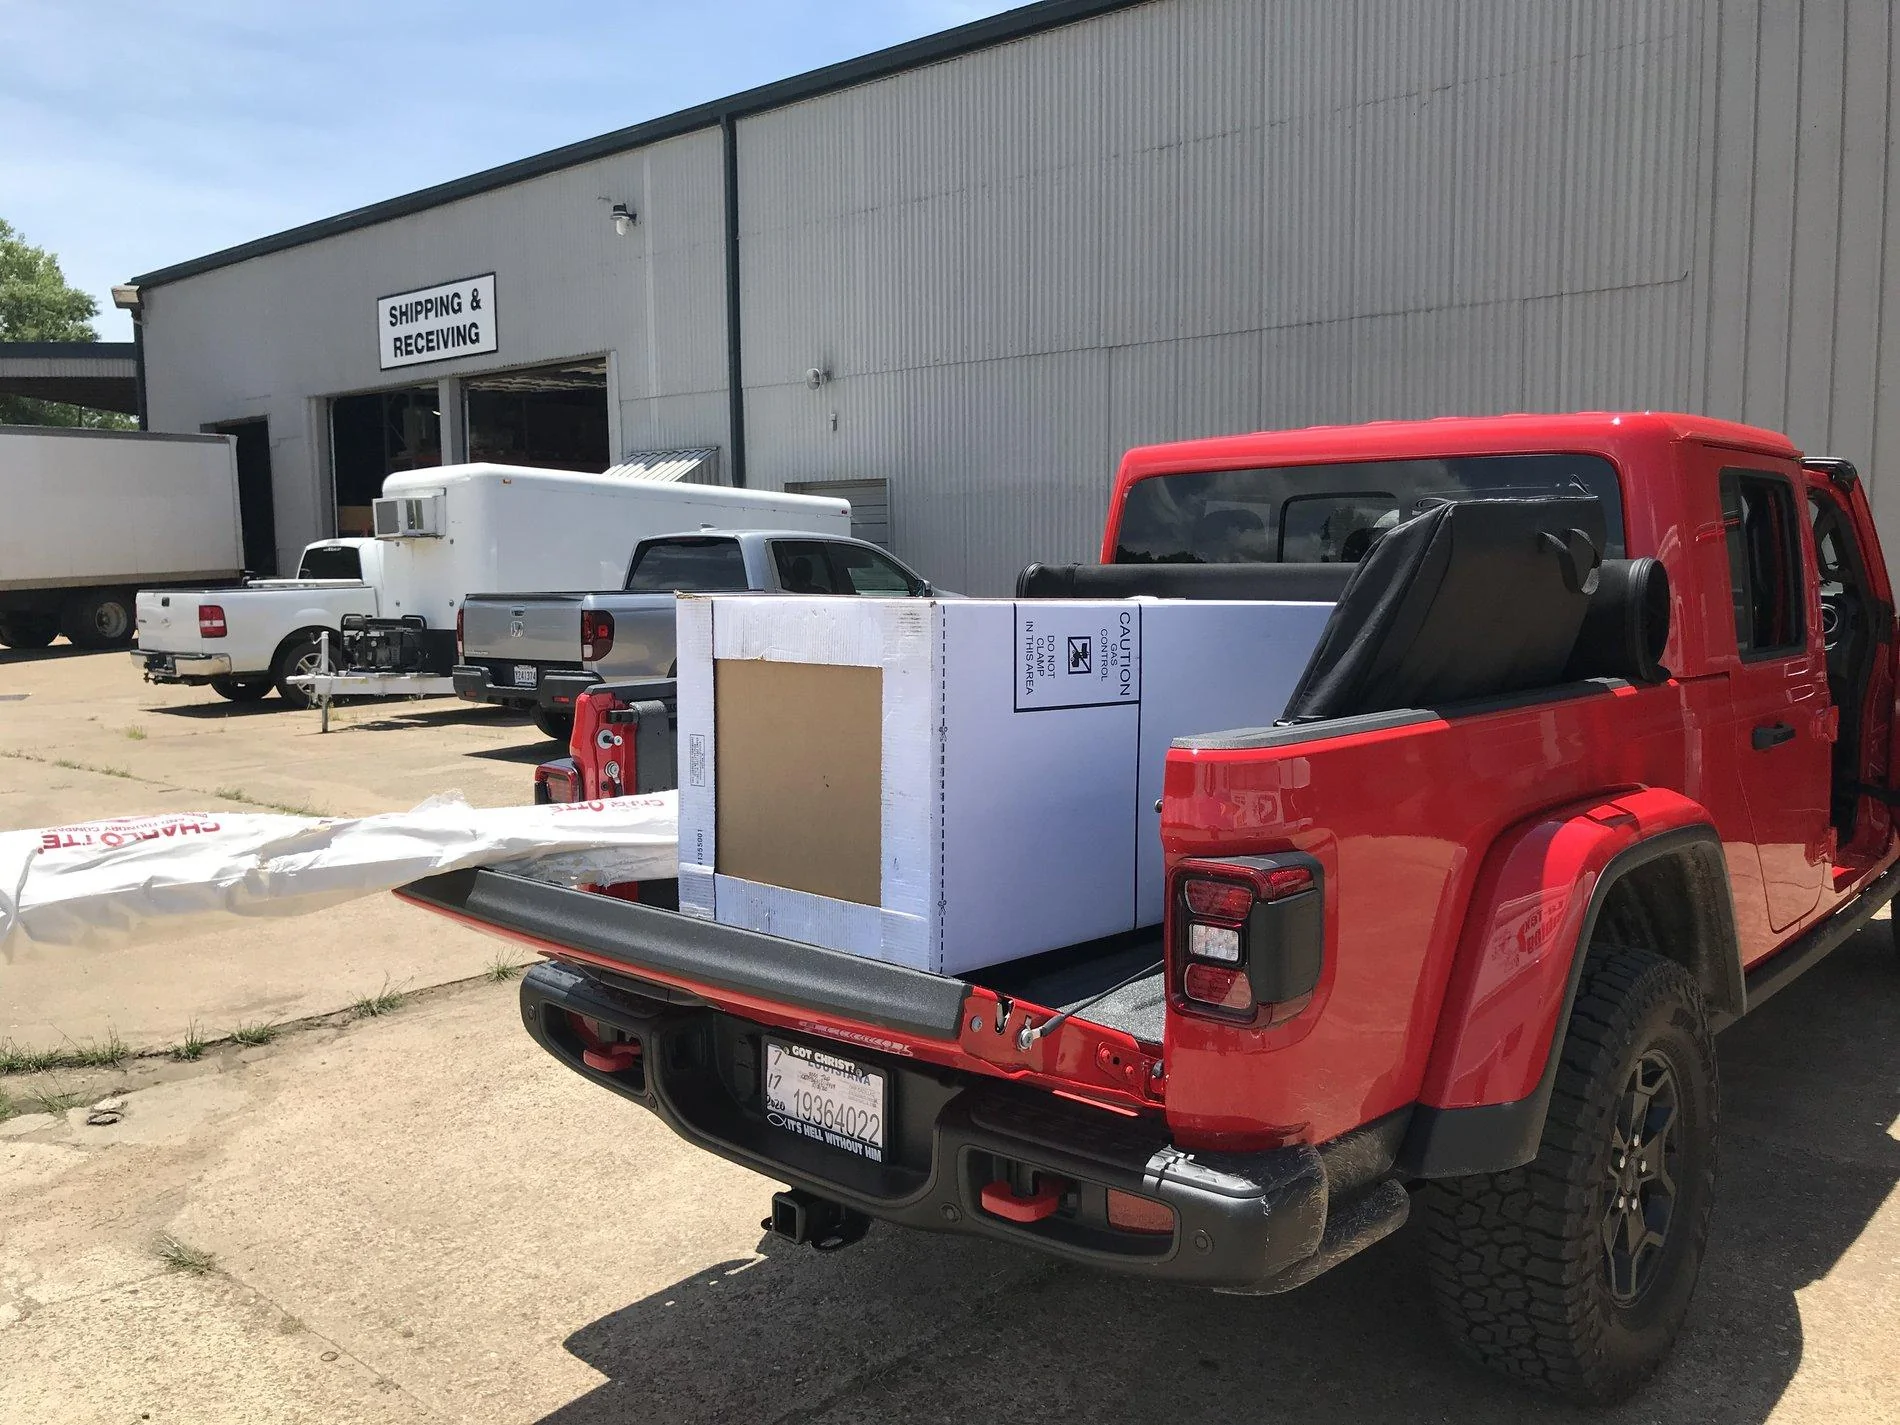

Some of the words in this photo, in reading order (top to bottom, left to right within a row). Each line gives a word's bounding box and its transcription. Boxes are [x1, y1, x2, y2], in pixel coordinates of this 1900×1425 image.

[389, 292, 462, 327] SHIPPING
[470, 288, 482, 311] &
[393, 322, 480, 358] RECEIVING
[1025, 620, 1034, 632] IN
[1025, 635, 1034, 662] THIS
[1036, 637, 1045, 677] CLAMP
[1047, 635, 1055, 652] DO
[1100, 628, 1109, 681] CONTROL
[1110, 643, 1118, 666] GAS
[1119, 611, 1131, 696] CAUTION
[1025, 664, 1034, 696] AREA
[1047, 656, 1056, 679] NOT
[774, 1049, 783, 1066] 7
[792, 1045, 812, 1060] GOT
[814, 1052, 855, 1073] CHRIST?
[768, 1073, 782, 1090] 17
[793, 1088, 880, 1145] 19364022
[787, 1118, 802, 1134] IT'S
[803, 1123, 824, 1142] HELL
[825, 1130, 863, 1156] WITHOUT
[864, 1145, 882, 1163] HIM
